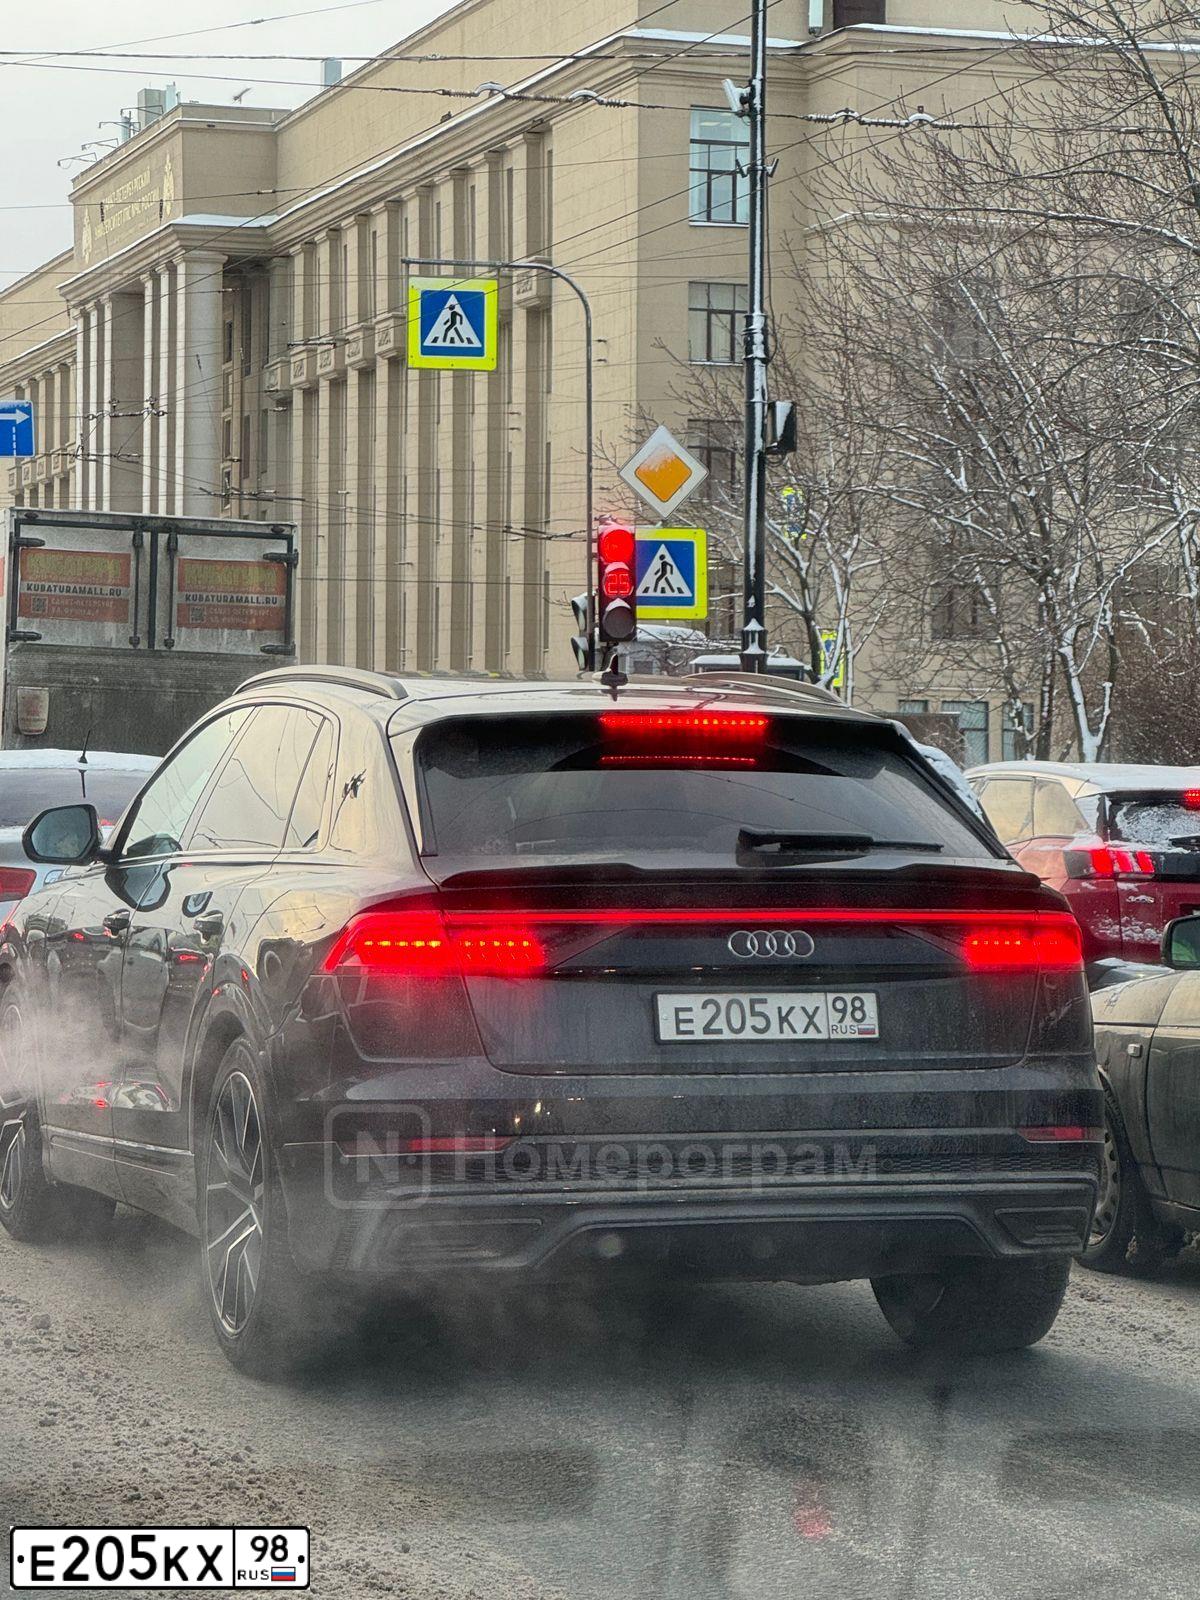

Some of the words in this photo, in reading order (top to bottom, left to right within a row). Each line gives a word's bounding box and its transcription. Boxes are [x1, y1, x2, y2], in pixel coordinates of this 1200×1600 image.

[26, 582, 122, 597] KUBATURAMALL.RU
[607, 573, 630, 594] 25
[185, 593, 278, 605] KUBATURAMALL.RU
[674, 997, 822, 1036] Е205КХ
[832, 996, 867, 1024] 98
[831, 1024, 857, 1035] RUS
